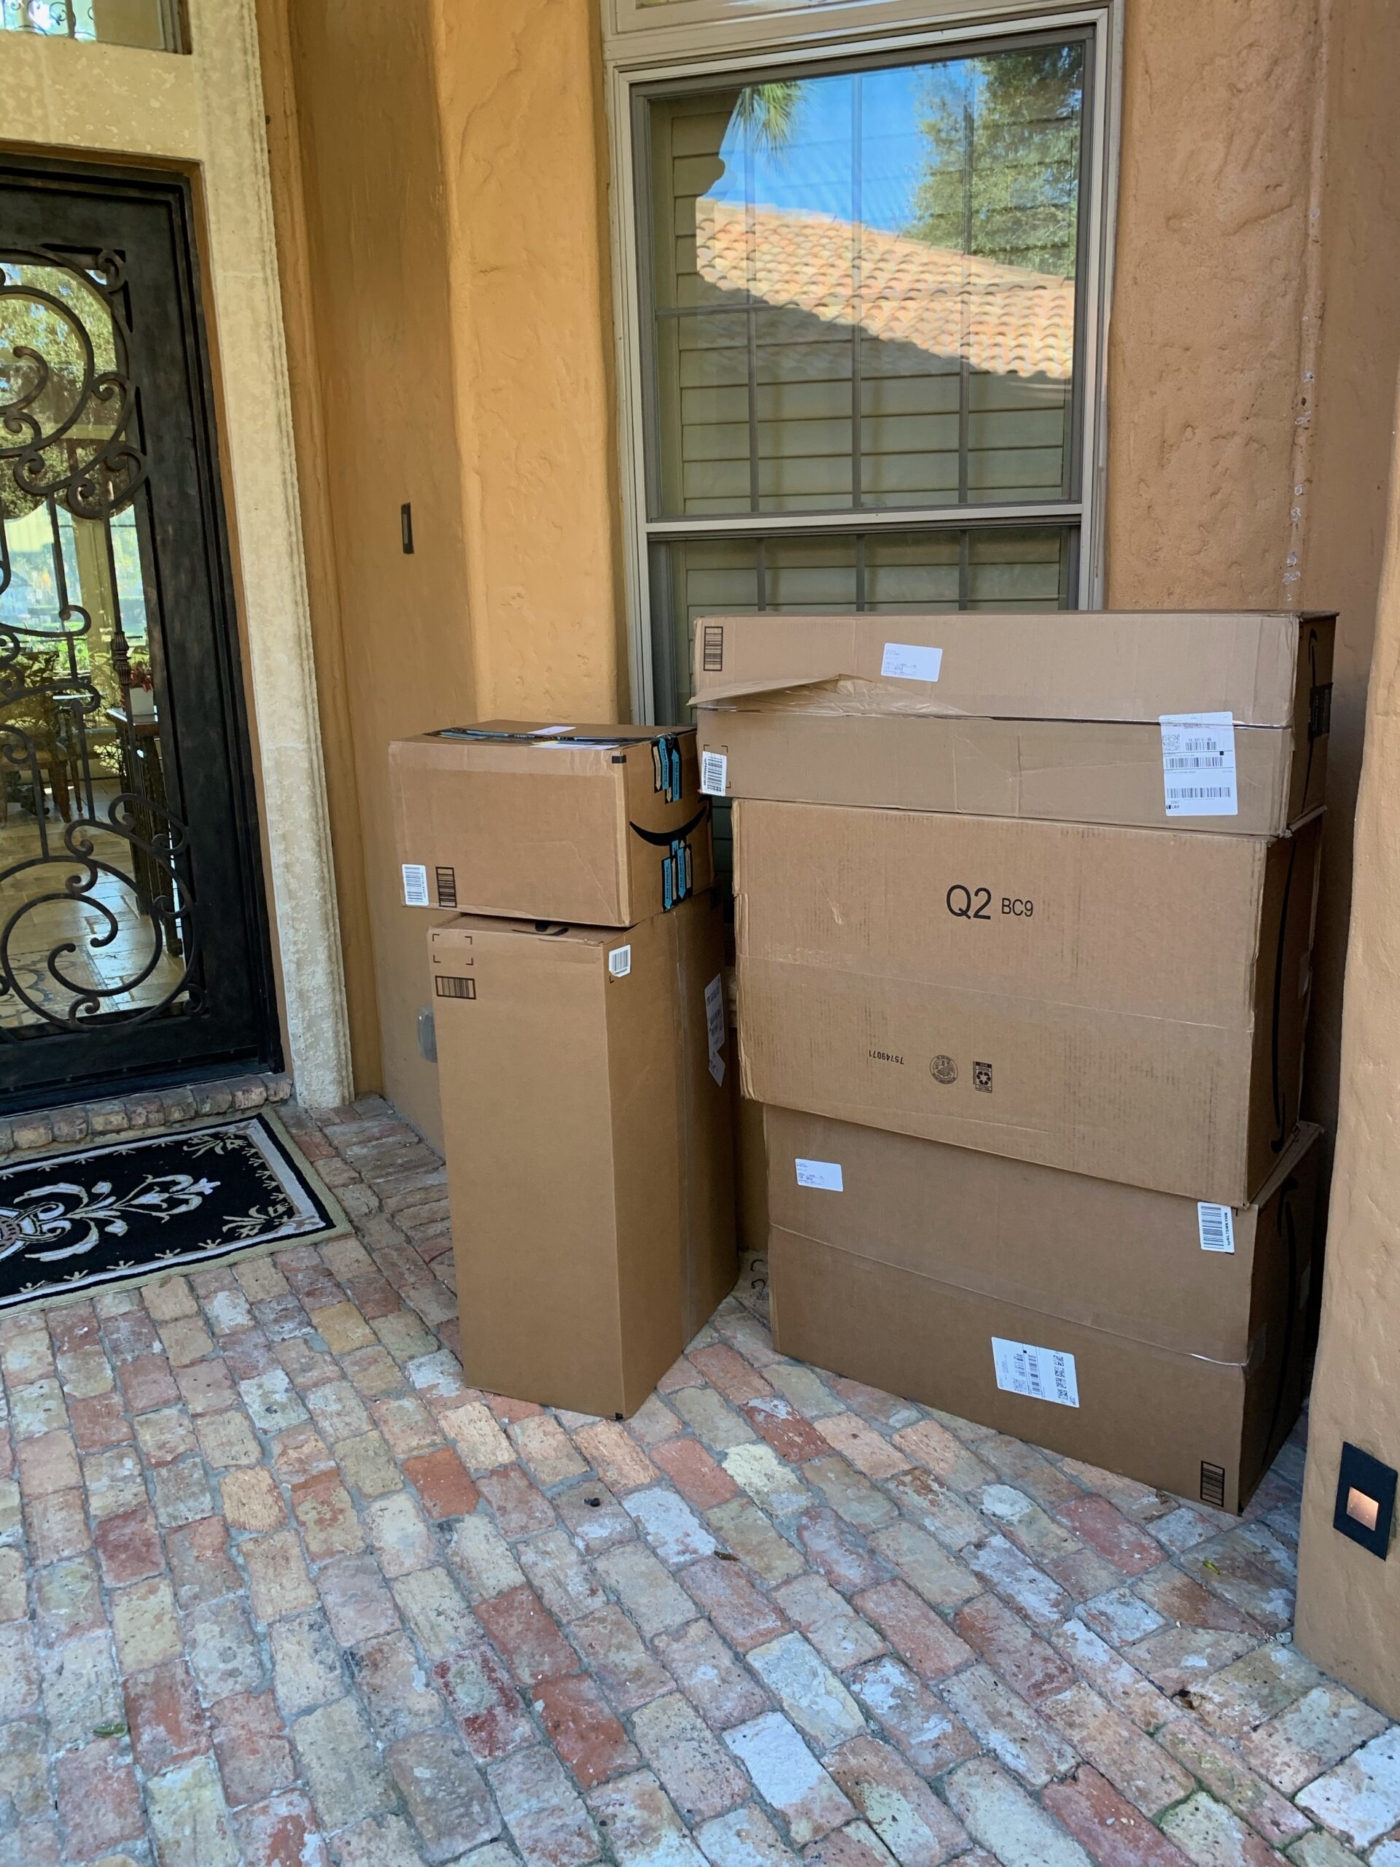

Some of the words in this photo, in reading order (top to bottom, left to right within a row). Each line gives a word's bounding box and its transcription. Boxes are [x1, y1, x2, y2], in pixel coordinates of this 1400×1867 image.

[946, 884, 992, 920] Q2
[1001, 897, 1034, 918] BC9
[868, 1049, 905, 1065] 75749071
